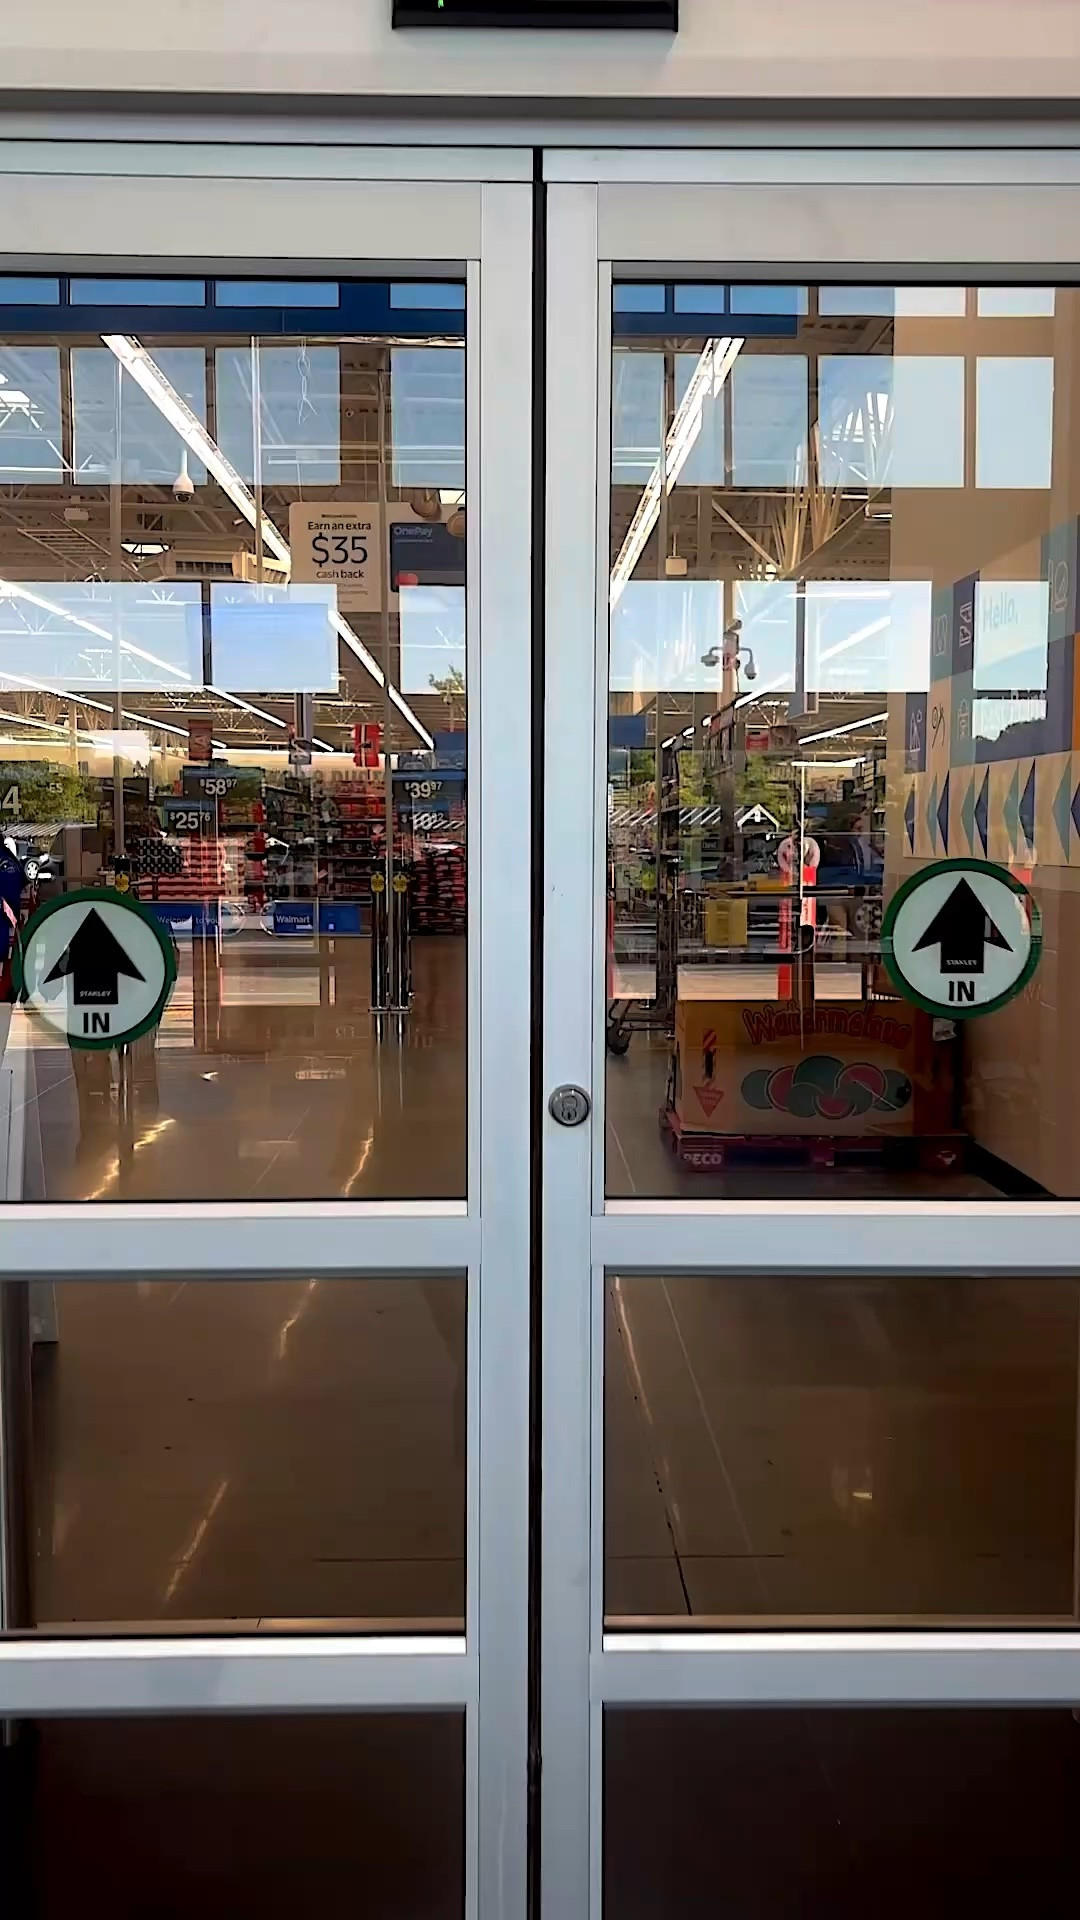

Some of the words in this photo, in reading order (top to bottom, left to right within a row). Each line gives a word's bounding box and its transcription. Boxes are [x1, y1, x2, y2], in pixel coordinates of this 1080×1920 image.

[308, 521, 331, 531] Earn
[332, 523, 344, 531] an
[345, 522, 371, 531] extra
[311, 532, 368, 567] $35
[316, 569, 338, 579] cash
[340, 569, 364, 579] back
[275, 914, 311, 924] Walmart
[948, 980, 976, 1002] IN
[83, 1012, 110, 1034] IN
